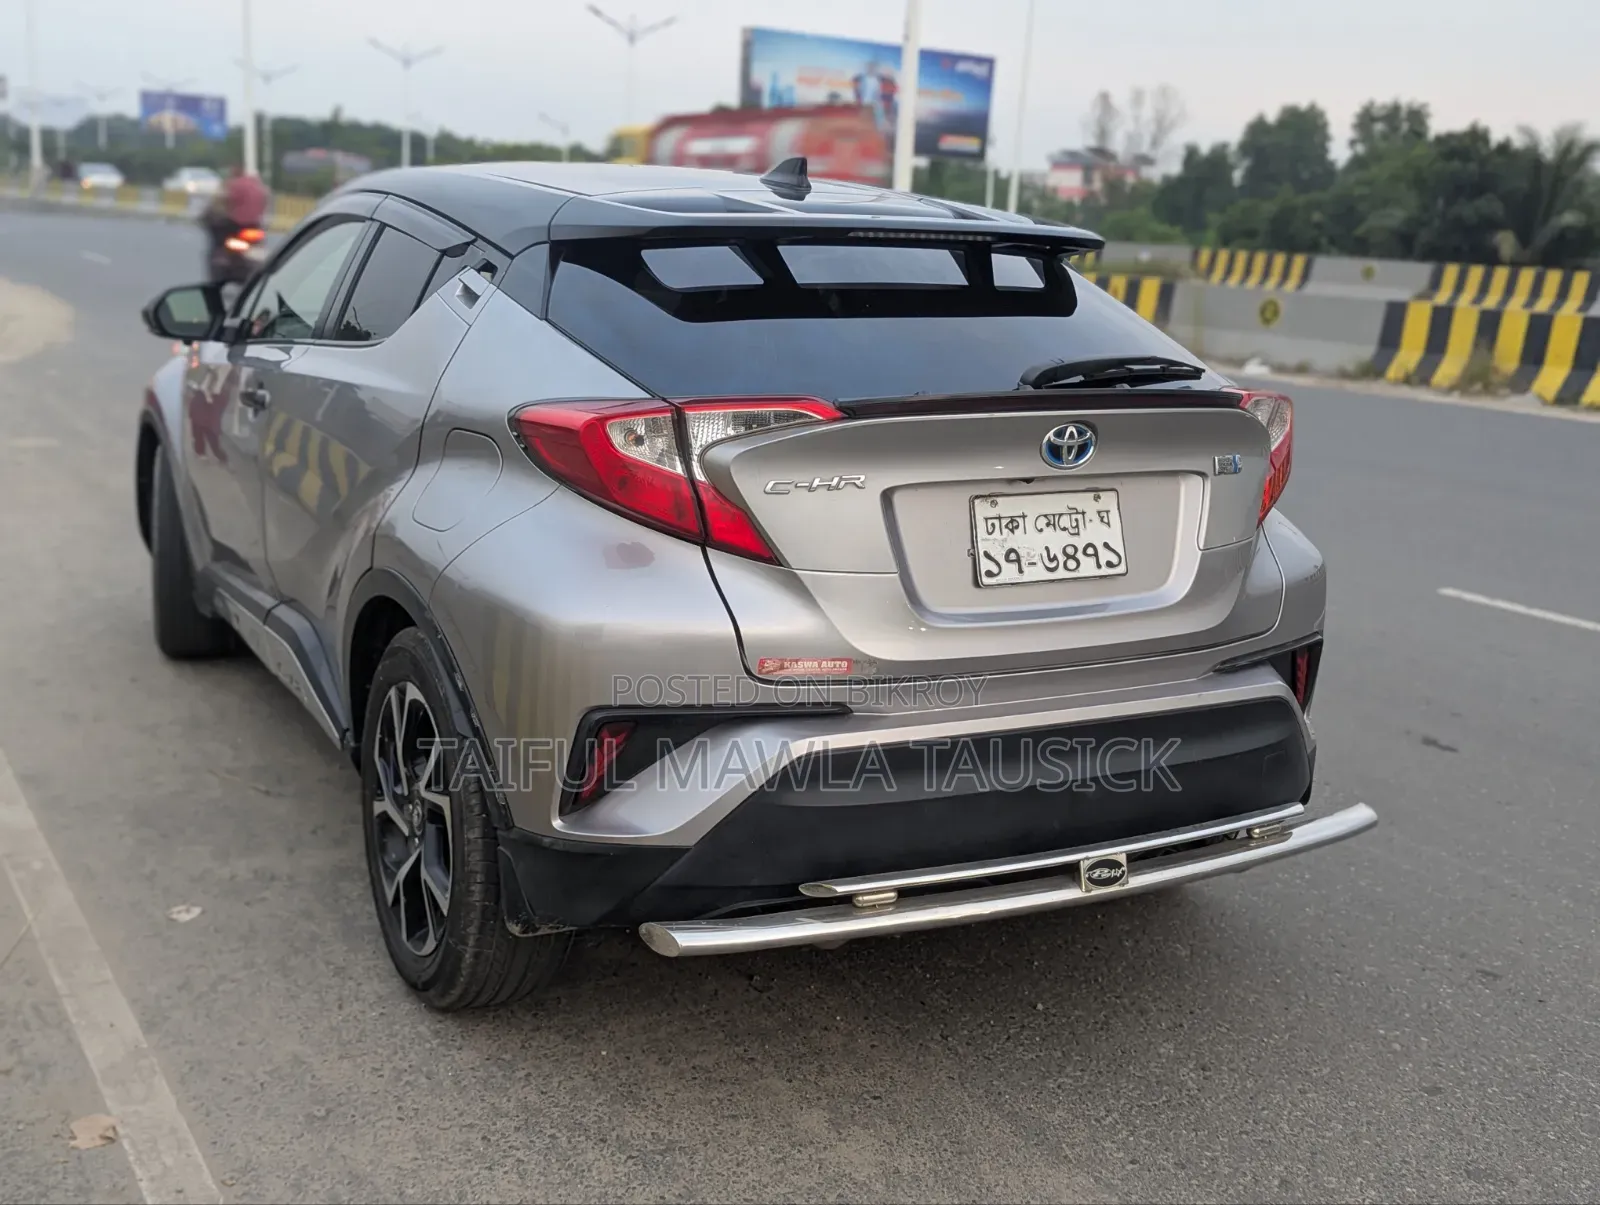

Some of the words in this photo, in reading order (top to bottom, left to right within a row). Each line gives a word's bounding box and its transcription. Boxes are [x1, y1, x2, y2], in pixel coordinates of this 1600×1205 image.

[763, 474, 866, 495] C-HR
[983, 512, 1028, 536] ঢাকা
[983, 541, 1123, 578] ১৭-৬৪৭১
[783, 660, 819, 669] KASWA
[820, 660, 848, 668] AUTO
